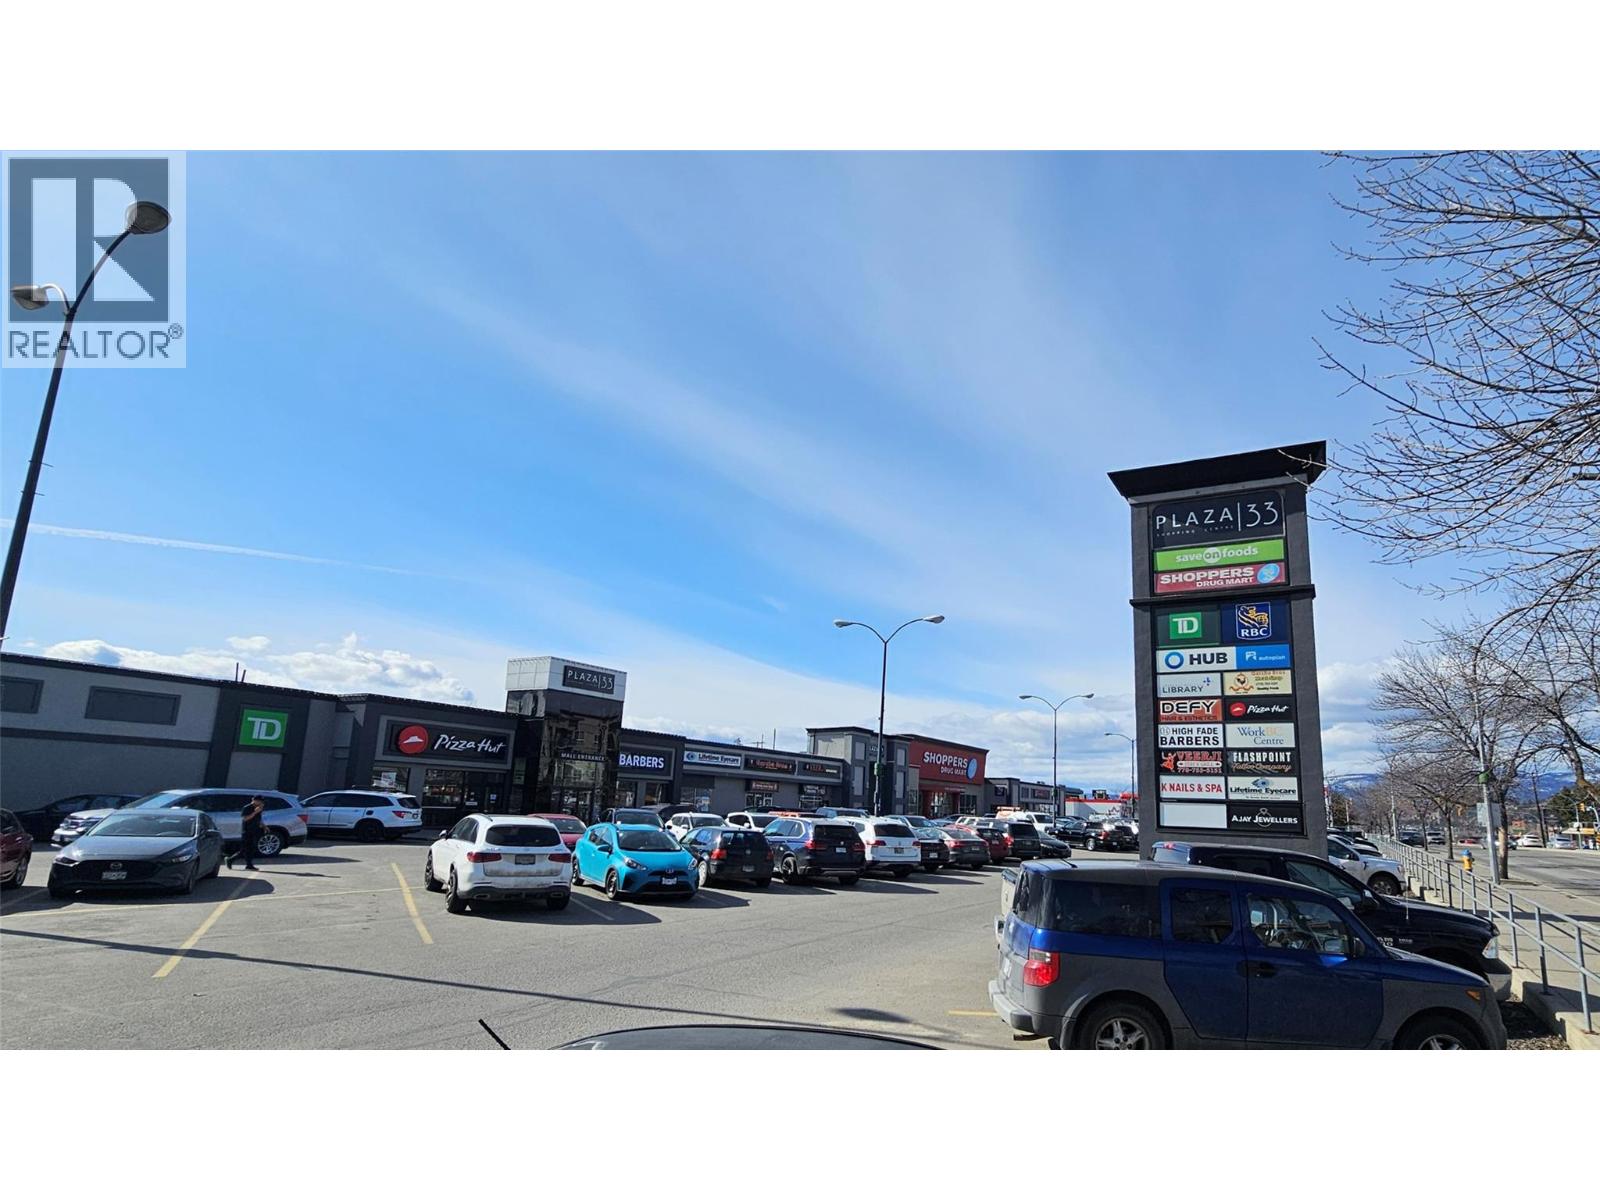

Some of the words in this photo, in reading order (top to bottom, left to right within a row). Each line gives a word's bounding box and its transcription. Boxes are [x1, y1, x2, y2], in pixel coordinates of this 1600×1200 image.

[1160, 567, 1254, 584] SHOPPERS
[1196, 579, 1224, 588] DRUG
[1226, 577, 1254, 586] MART
[1172, 616, 1199, 634] TD
[1241, 628, 1268, 637] RBC
[1189, 653, 1228, 666] HUB
[1162, 685, 1204, 694] LIBRARY
[1161, 701, 1216, 714] DEFY
[1247, 705, 1271, 714] Pizza
[1271, 705, 1289, 713] Hut
[247, 717, 282, 741] TD
[1172, 727, 1193, 735] HIGH
[1196, 727, 1219, 735] FADE
[434, 734, 475, 751] Pizza
[477, 738, 507, 754] Hut
[1160, 736, 1220, 746] BARBERS
[1253, 737, 1285, 745] Centre
[619, 753, 665, 769] BARBERS
[923, 751, 968, 769] SHOPPERS
[1233, 751, 1292, 762] FLASHPOINT
[1161, 783, 1168, 792] K
[1169, 783, 1195, 792] NAILS
[1196, 783, 1203, 792] &
[1205, 784, 1223, 793] SPA
[1230, 786, 1261, 794] Lifetime
[1265, 787, 1297, 795] Eyecare
